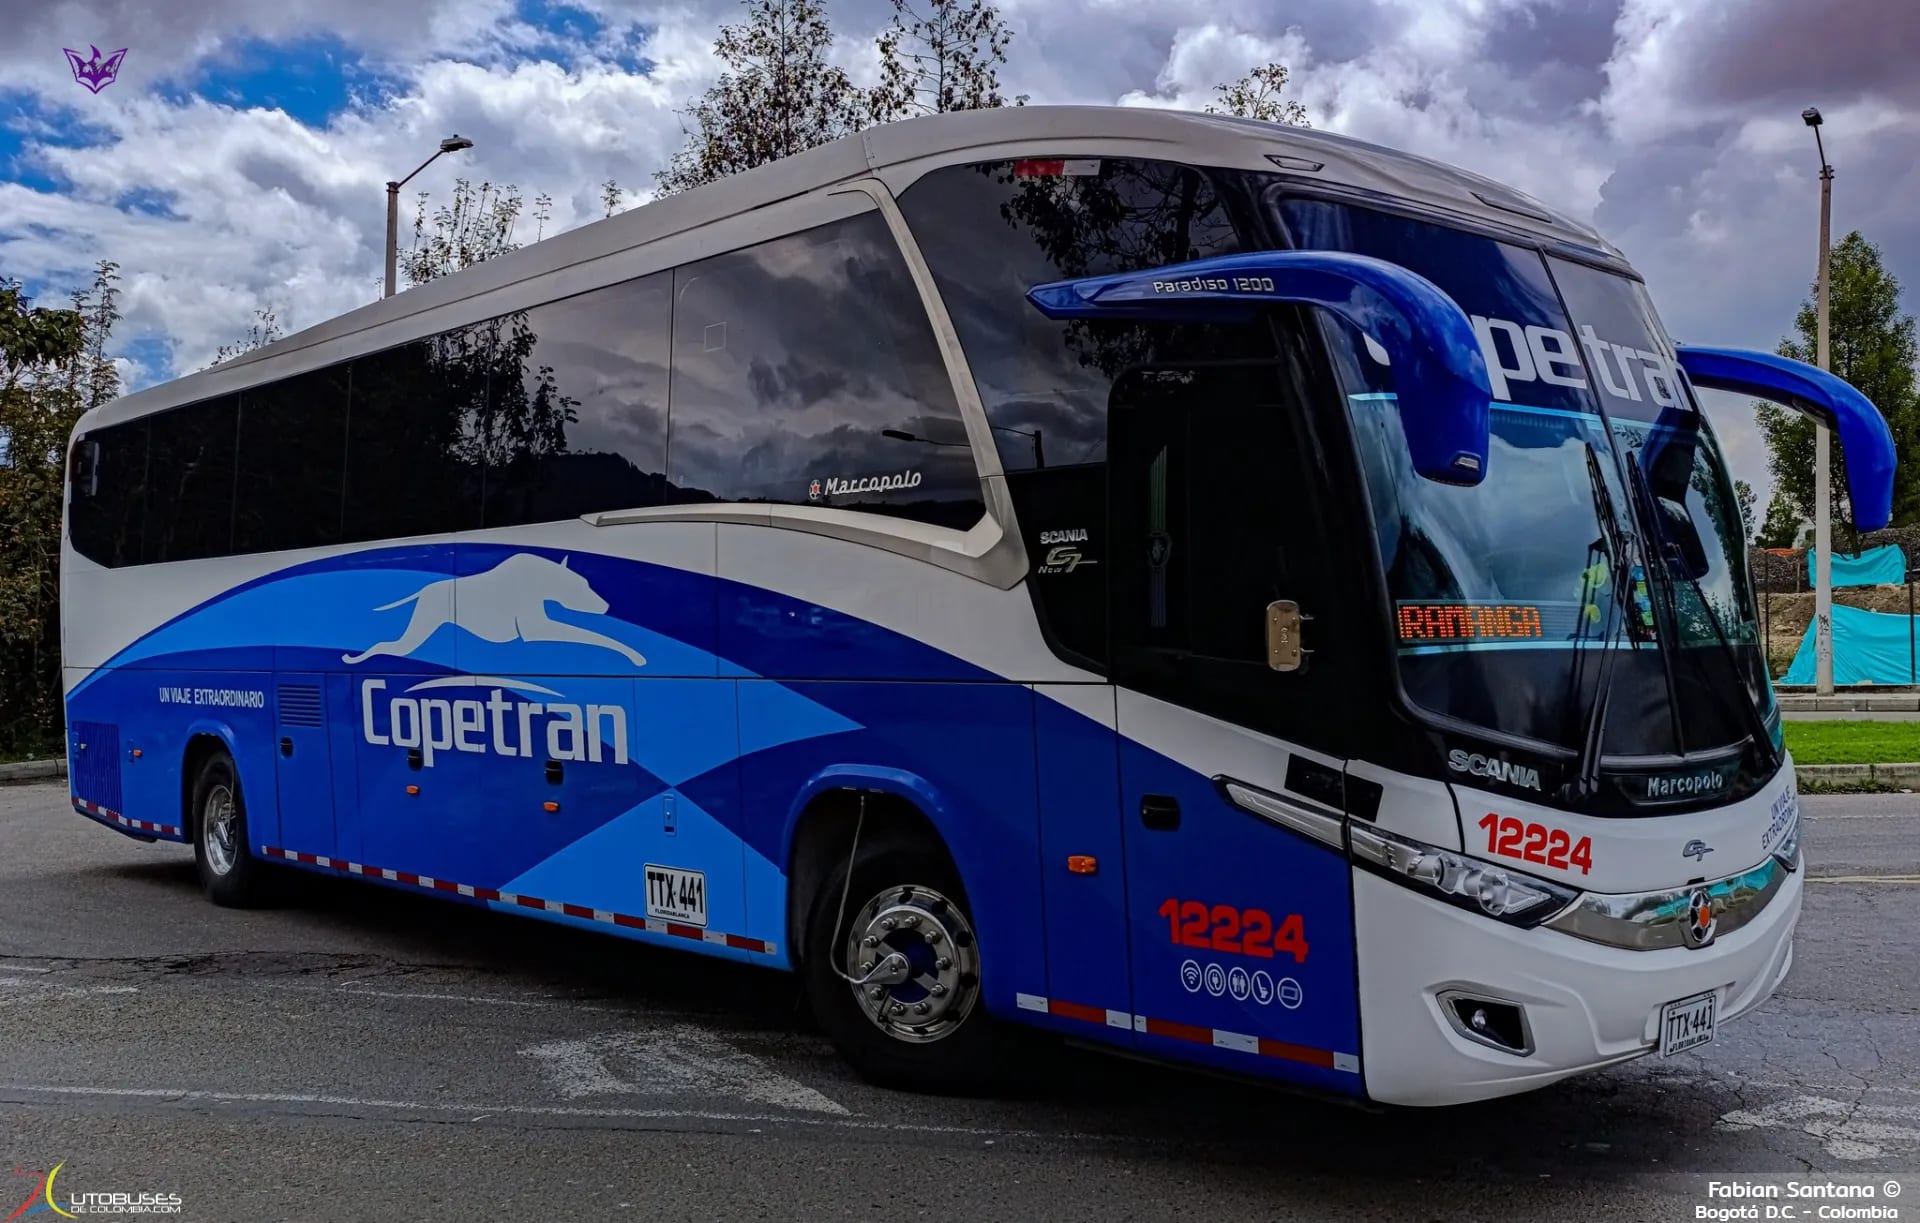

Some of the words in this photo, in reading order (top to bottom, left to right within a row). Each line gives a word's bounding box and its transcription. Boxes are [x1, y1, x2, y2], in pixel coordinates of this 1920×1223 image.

[1153, 277, 1228, 293] Paradiso
[1233, 277, 1275, 292] 1200
[824, 469, 921, 496] Marcopolo
[1040, 528, 1088, 544] SCANIA
[1398, 606, 1543, 638] RAMANGA
[159, 687, 170, 703] UN
[170, 687, 192, 704] VIAJE
[194, 688, 265, 709] EXTRAORDINARIO
[362, 679, 629, 768] Copetran
[1448, 750, 1542, 791] SCANIA
[1647, 771, 1723, 797] Marcopolo
[1478, 813, 1592, 876] 12224
[1158, 898, 1310, 964] 12224
